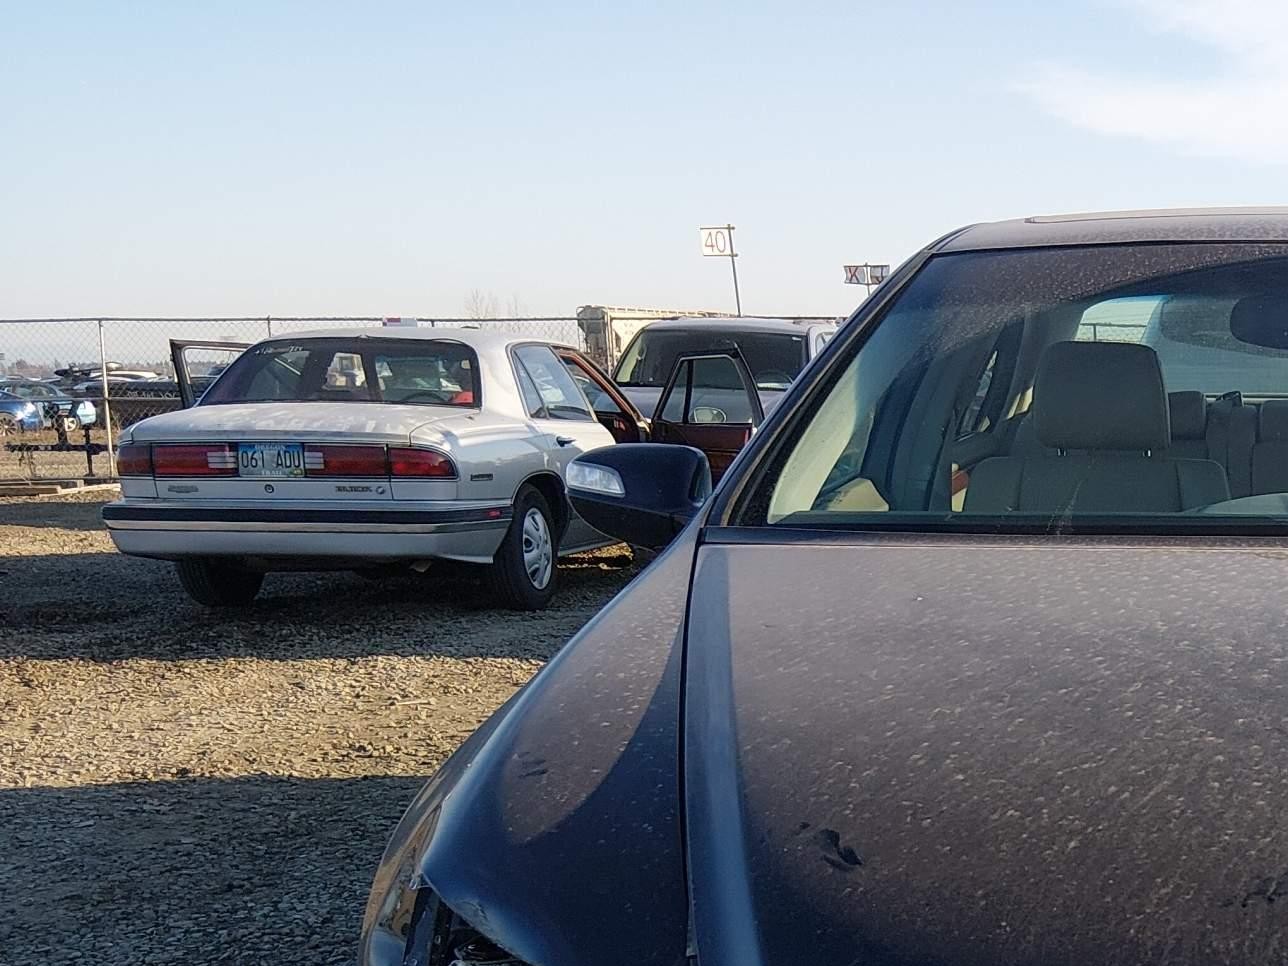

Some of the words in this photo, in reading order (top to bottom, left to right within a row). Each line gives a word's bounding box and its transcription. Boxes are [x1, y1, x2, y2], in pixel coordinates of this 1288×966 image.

[704, 230, 727, 253] 40
[241, 450, 265, 469] 061
[275, 450, 301, 469] ADU
